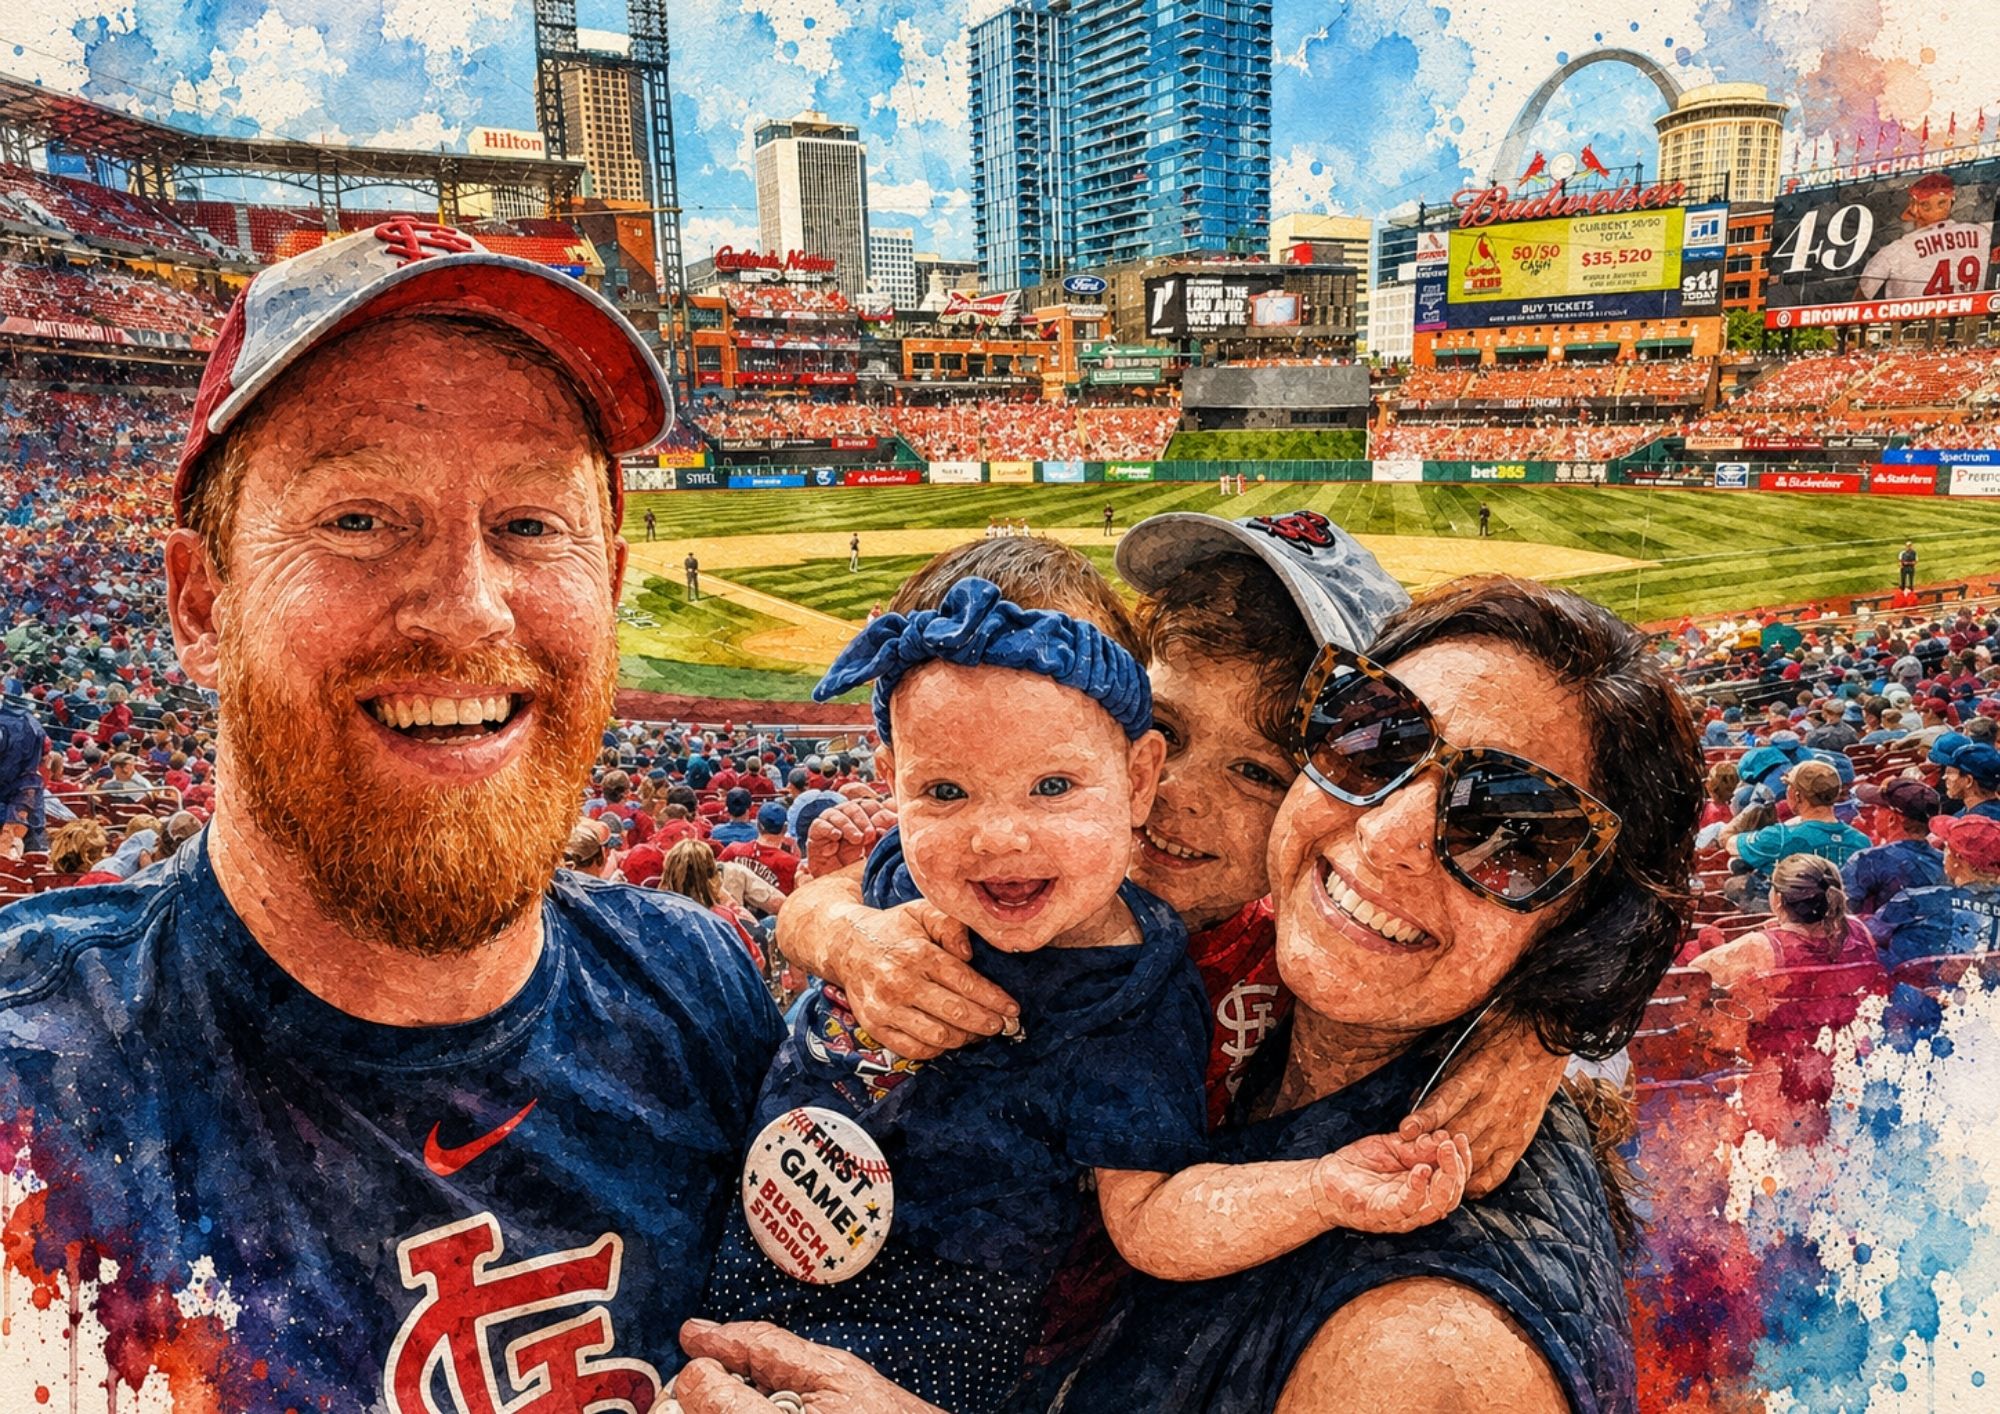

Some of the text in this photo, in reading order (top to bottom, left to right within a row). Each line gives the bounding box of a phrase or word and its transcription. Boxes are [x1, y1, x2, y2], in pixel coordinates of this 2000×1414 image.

[484, 131, 543, 151] Hilton
[1451, 179, 1687, 228] Budweiser
[1772, 203, 1874, 274] 49
[1582, 248, 1652, 268] $35,520
[1070, 277, 1100, 292] Ford
[1923, 256, 1981, 296] 49
[1522, 300, 1594, 314] BUY TICKETS
[1682, 290, 1717, 300] TODAY
[1800, 307, 1859, 326] BROWN
[1877, 298, 1973, 319] CROUPPEN
[1939, 451, 1990, 463] Spectrum
[1471, 465, 1526, 479] bet365
[802, 1122, 873, 1197] FIRST
[780, 1148, 868, 1246] GAME!
[759, 1178, 829, 1260] BUSCH
[750, 1197, 816, 1276] STADIUM
